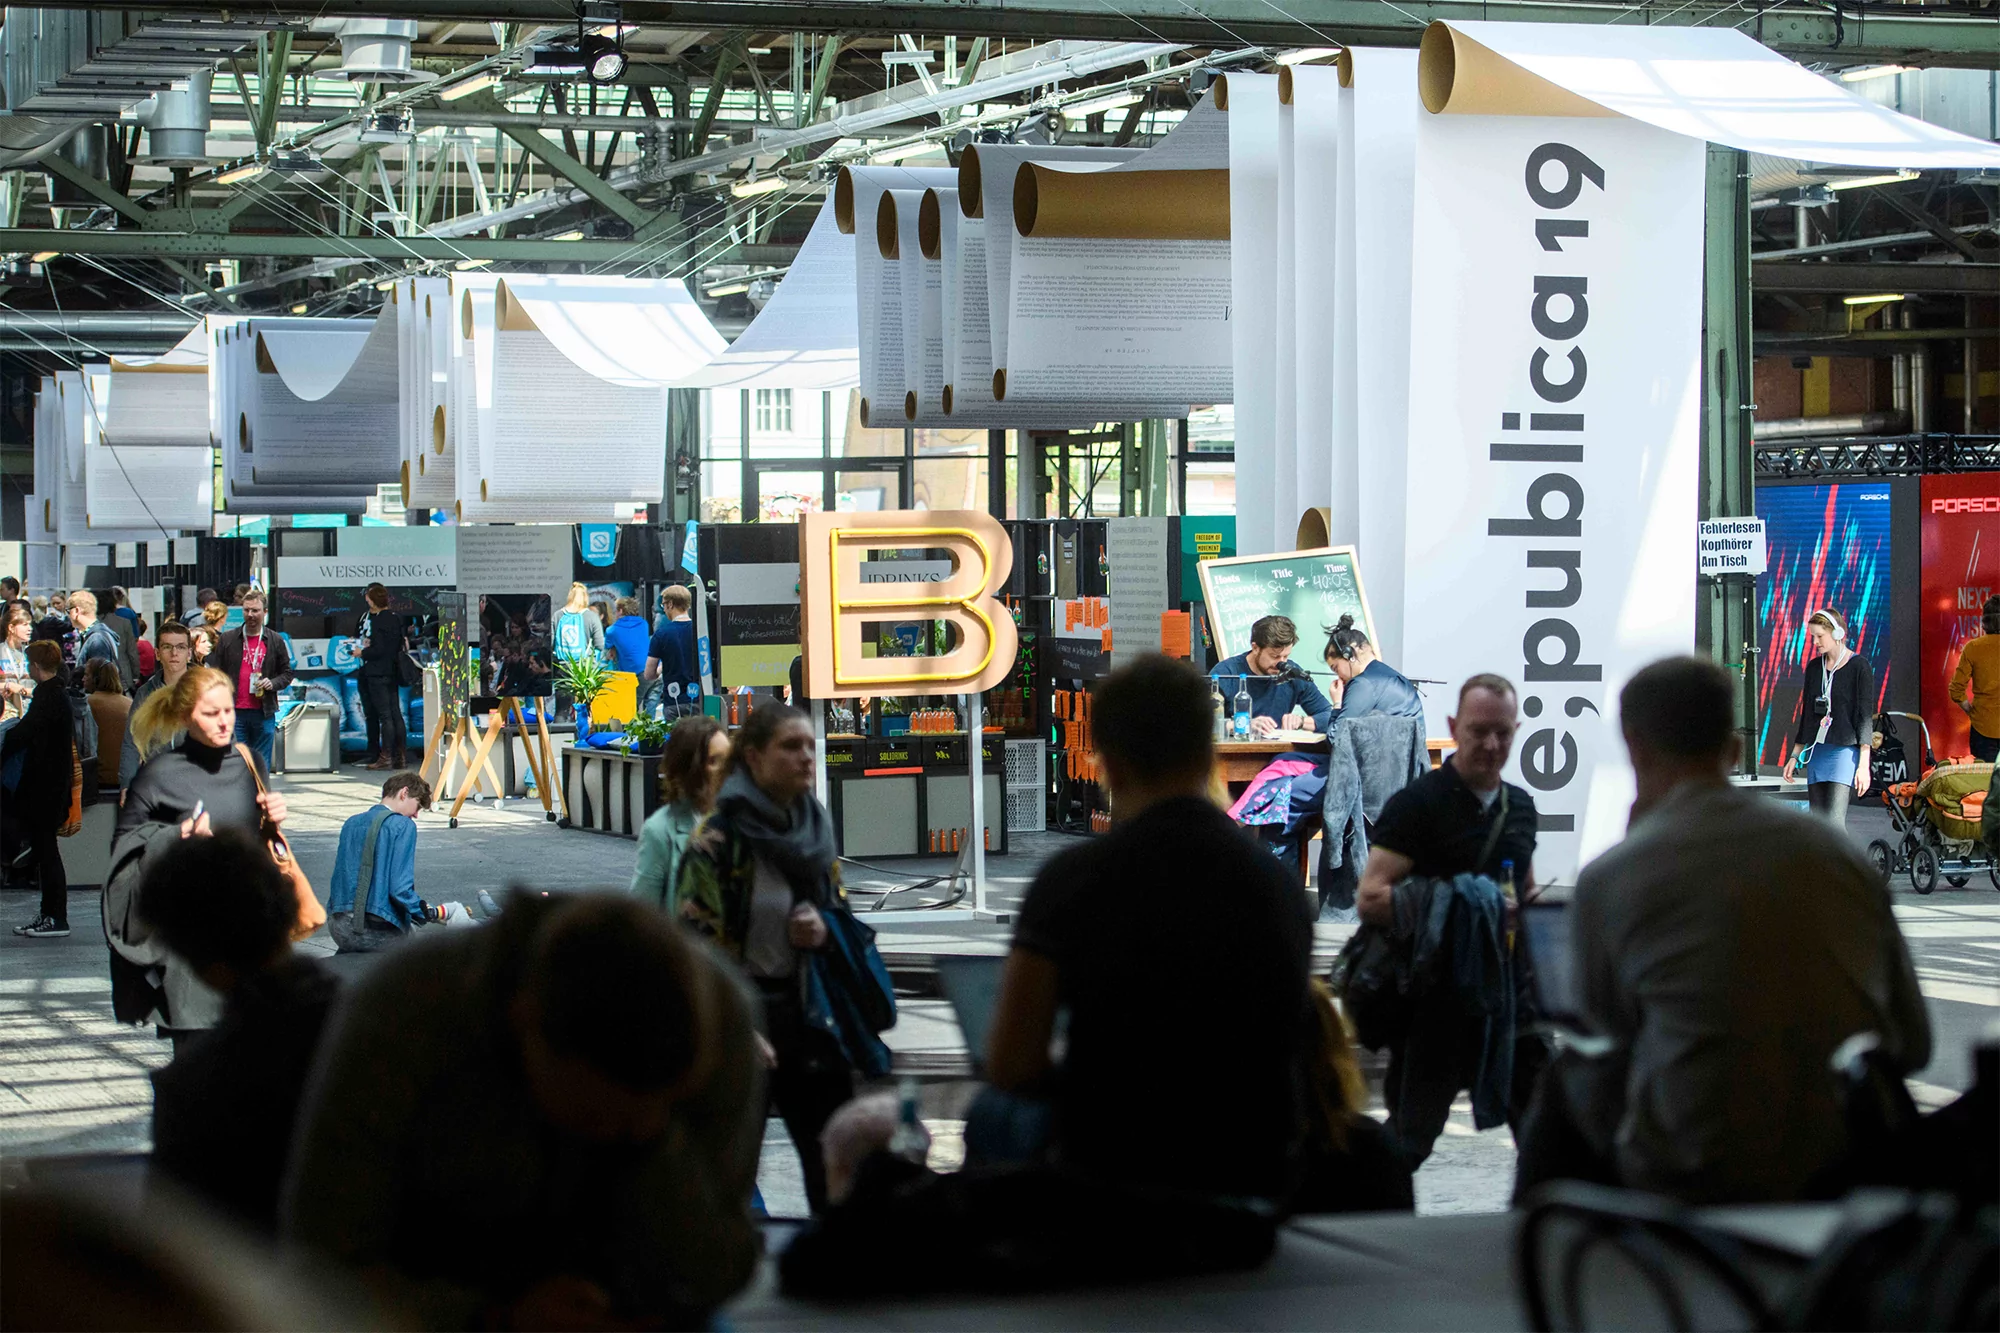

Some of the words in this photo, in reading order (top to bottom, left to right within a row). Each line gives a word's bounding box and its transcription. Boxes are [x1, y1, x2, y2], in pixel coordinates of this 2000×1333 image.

[1700, 523, 1761, 534] Fehlerlesen
[1701, 538, 1752, 551] Kopfhörer
[1702, 556, 1717, 567] Am
[1720, 555, 1747, 566] Tisch
[320, 565, 384, 578] WEISSER
[388, 565, 422, 577] RING
[425, 565, 448, 577] e.V.
[869, 573, 940, 582] IDRINKS
[1214, 575, 1240, 585] Hosts
[1271, 568, 1293, 579] Title
[1324, 564, 1347, 573] Time
[1267, 581, 1290, 593] Sch.
[1313, 573, 1351, 589] 40:05
[1319, 588, 1357, 604] 16:37
[1958, 587, 1991, 609] NEXT
[801, 510, 1015, 701] B
[728, 612, 756, 629] Message
[1958, 616, 1985, 638] VISI
[753, 663, 789, 675] re;pu
[1021, 648, 1033, 698] MATE
[879, 751, 909, 761] SOLIDRINKS
